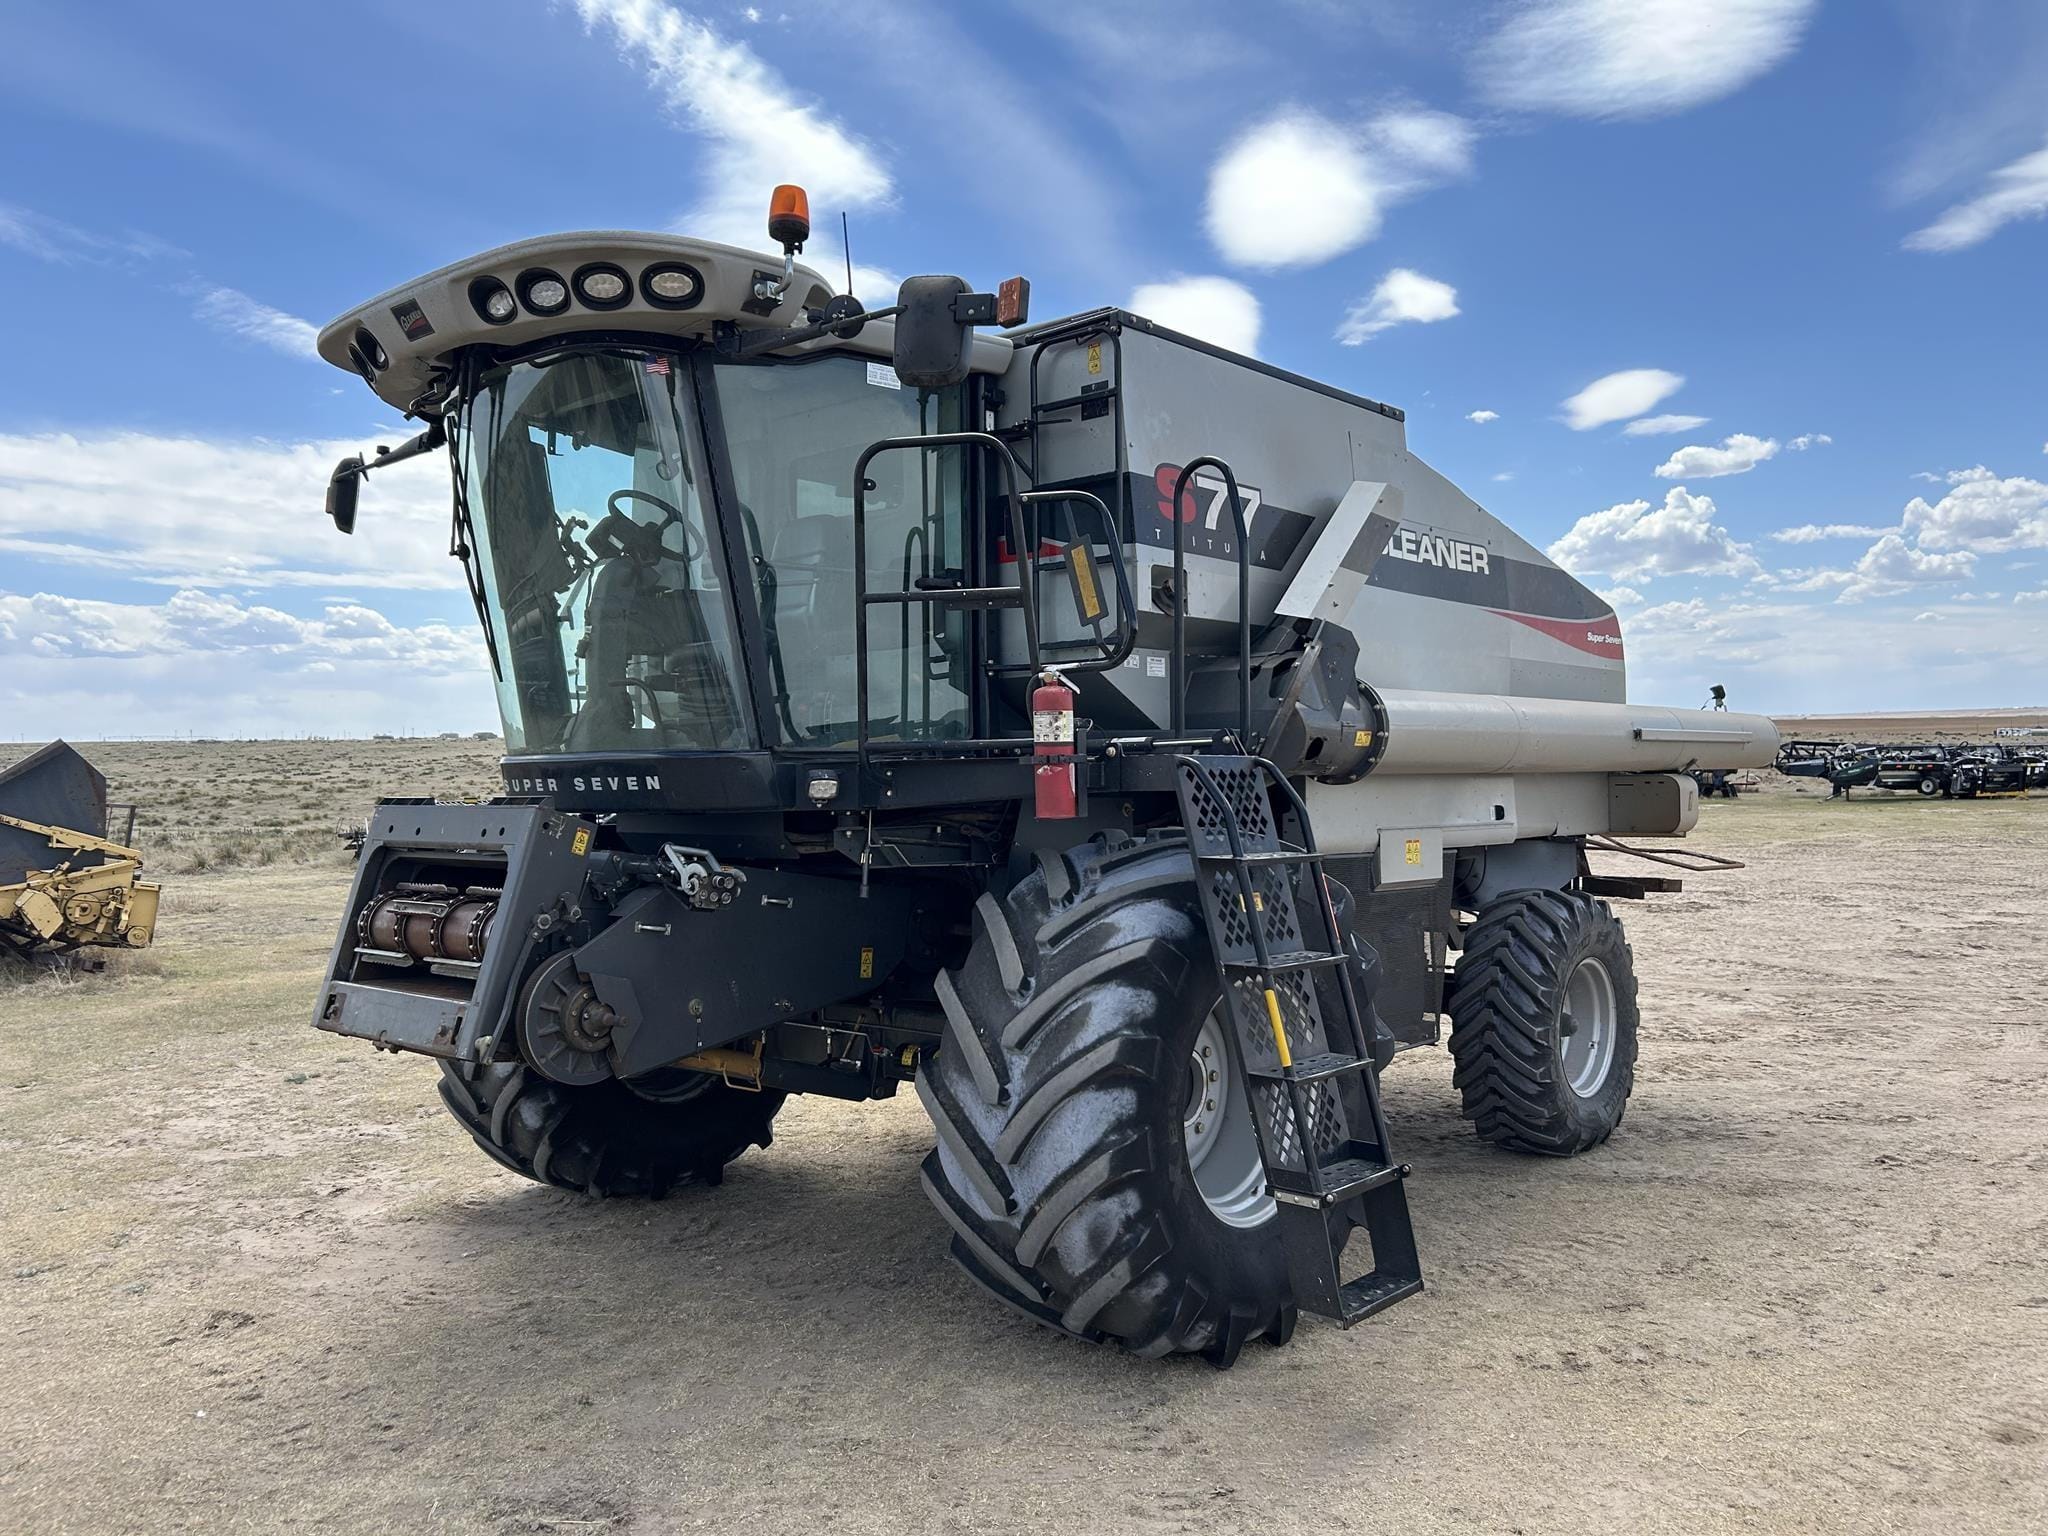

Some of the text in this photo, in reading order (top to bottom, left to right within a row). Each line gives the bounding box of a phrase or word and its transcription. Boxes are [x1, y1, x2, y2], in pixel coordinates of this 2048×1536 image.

[1155, 463, 1262, 538] S77
[1155, 528, 1266, 561] TITUA
[1382, 529, 1490, 575] LEANER
[1587, 631, 1622, 645] Super Seven
[504, 776, 661, 792] SUPER SEVEN
